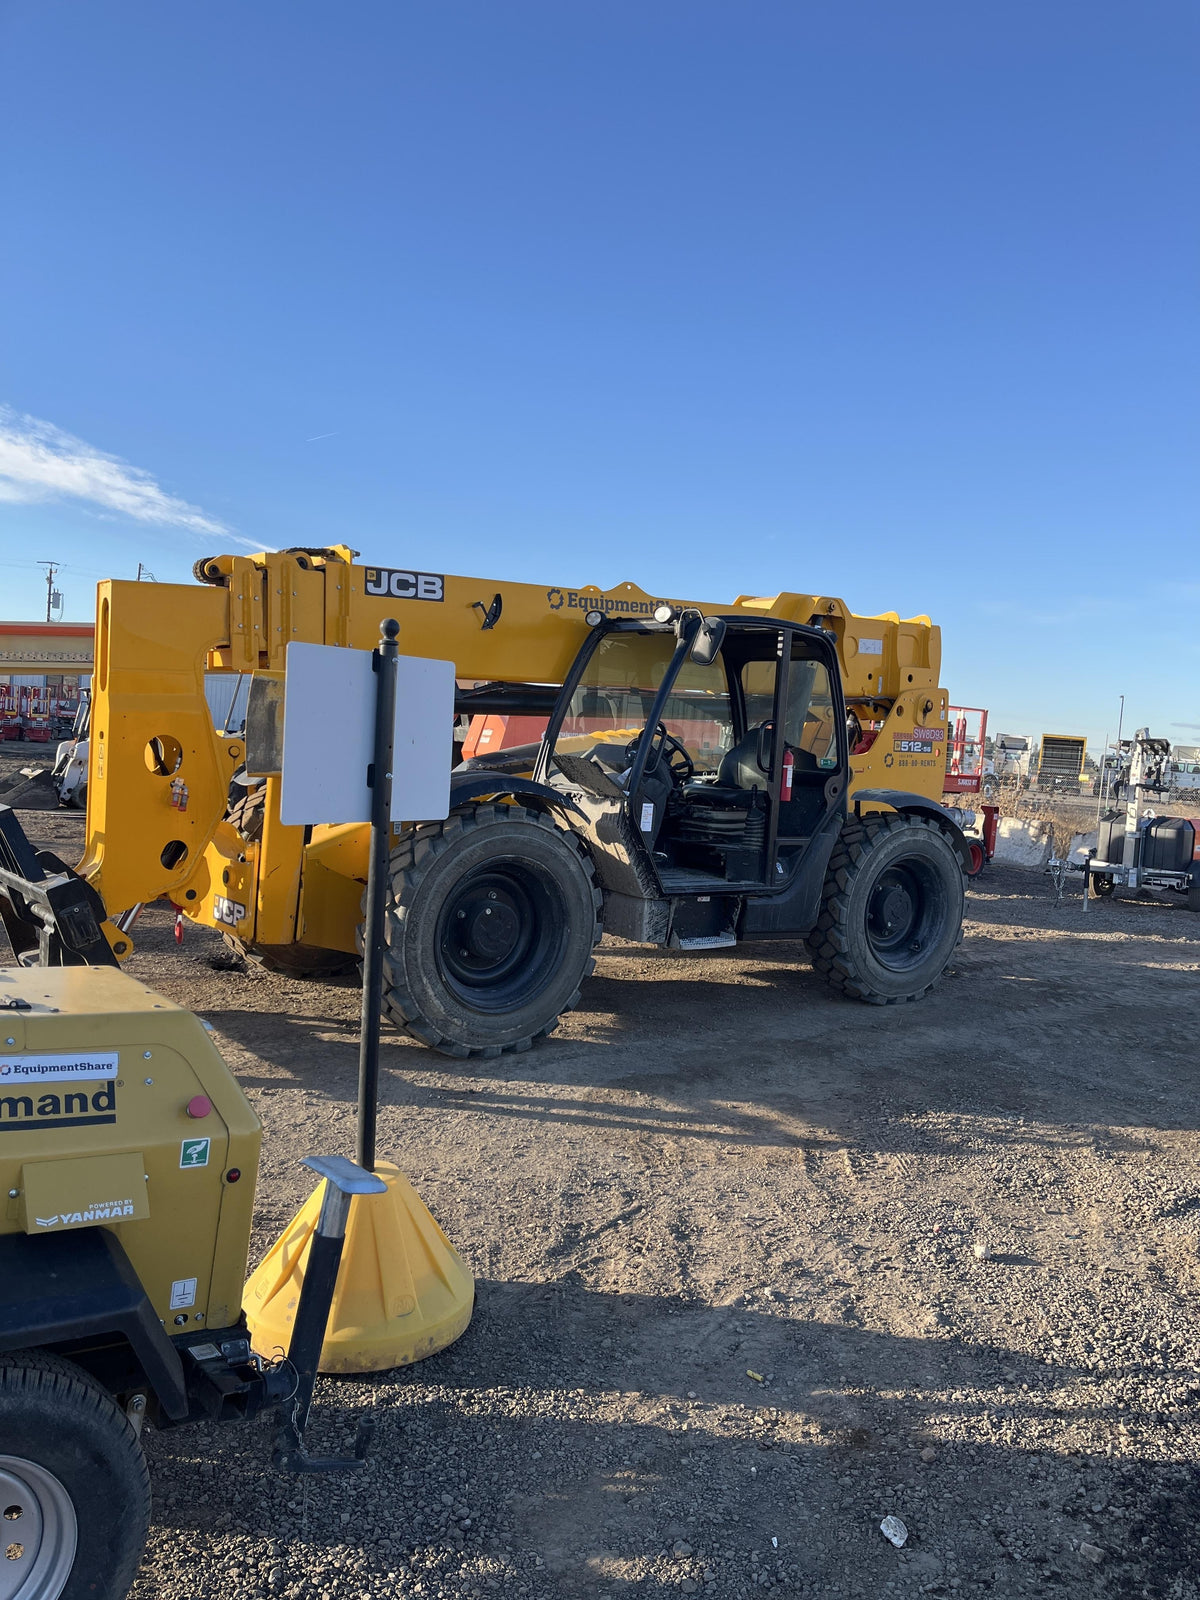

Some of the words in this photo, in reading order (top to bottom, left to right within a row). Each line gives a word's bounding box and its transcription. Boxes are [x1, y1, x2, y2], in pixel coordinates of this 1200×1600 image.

[366, 571, 443, 600] JCB
[567, 592, 698, 615] Equipmenta
[913, 728, 944, 740] SW8D93
[13, 1062, 113, 1075] EquipmentShare
[89, 1200, 123, 1210] POWERED
[60, 1205, 134, 1224] YANMAR
